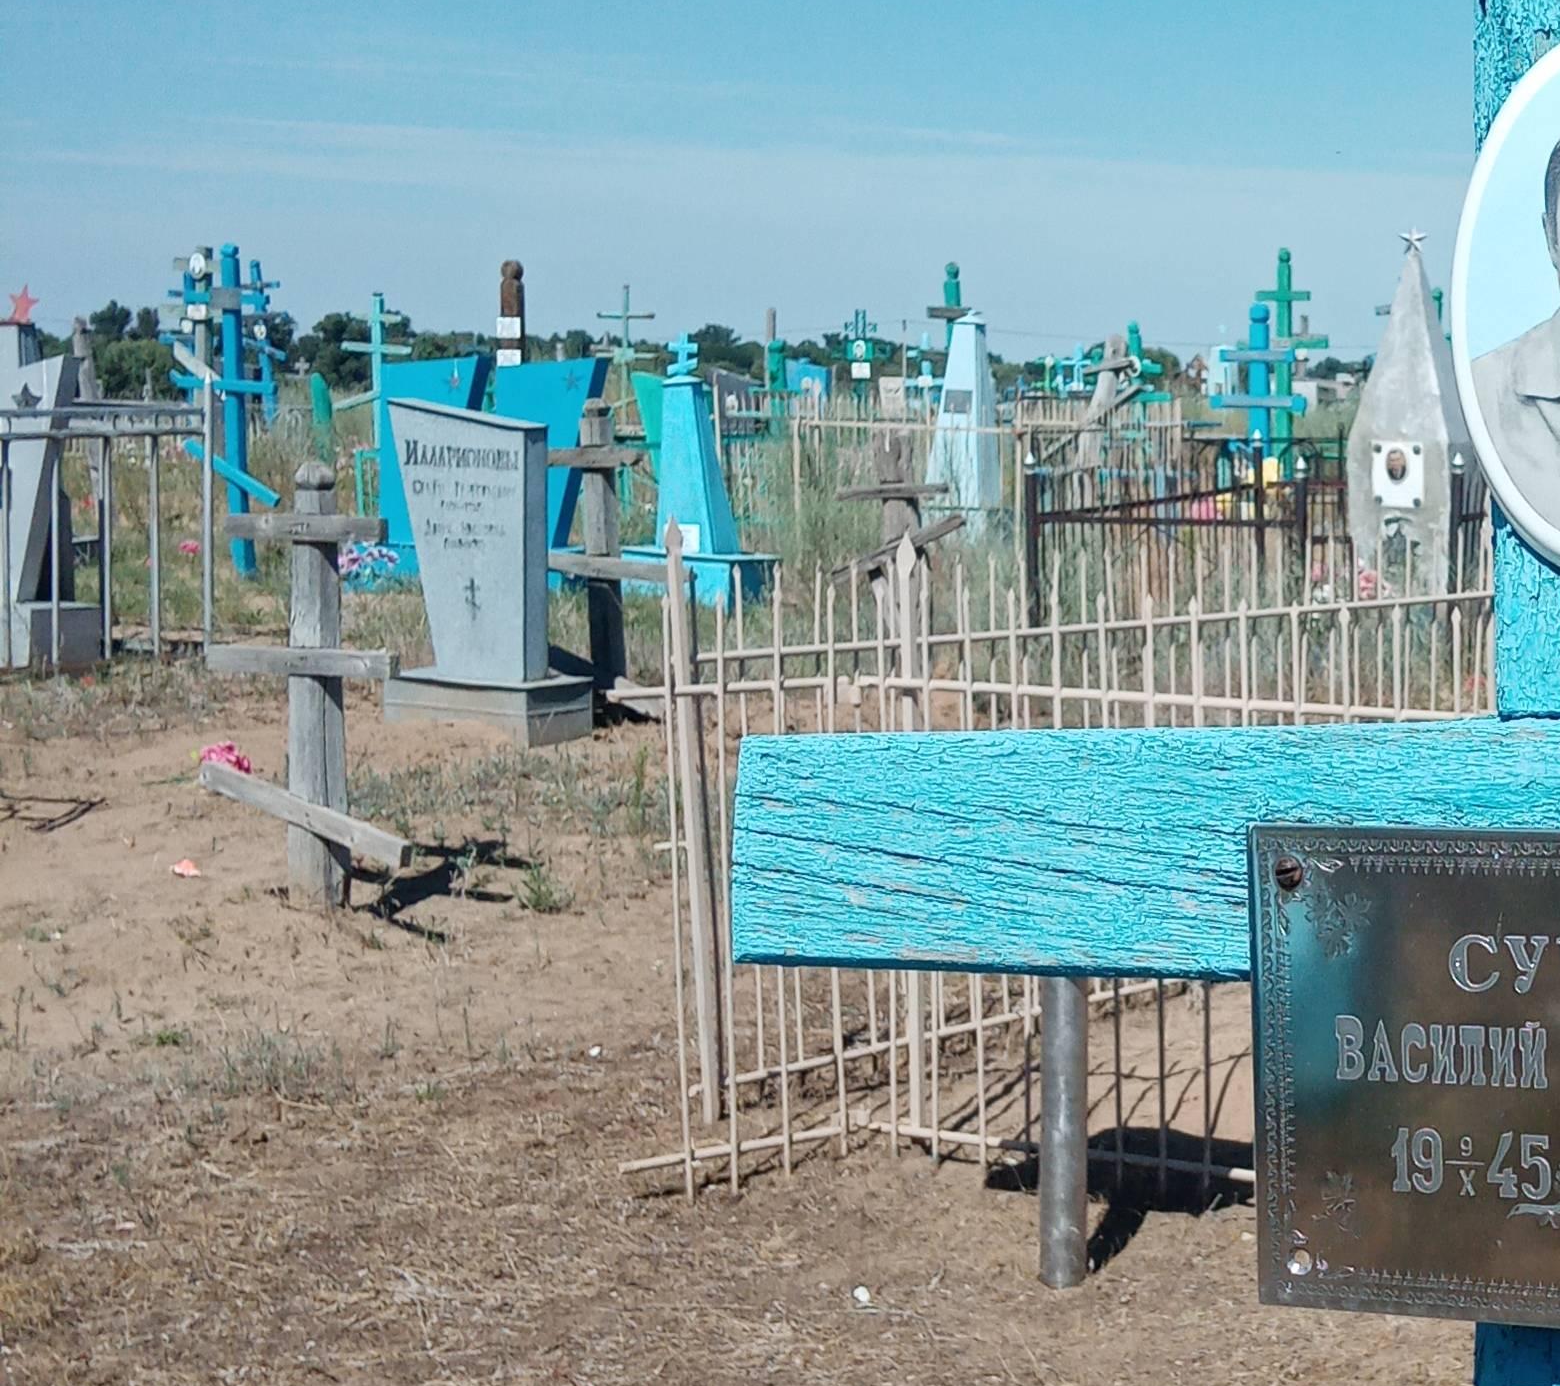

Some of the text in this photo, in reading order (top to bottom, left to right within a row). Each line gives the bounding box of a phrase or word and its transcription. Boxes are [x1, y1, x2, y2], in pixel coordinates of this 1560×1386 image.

[1334, 1014, 1550, 1090] ВАСИЛИЙ
[1391, 1127, 1444, 1193] 19
[1459, 1135, 1474, 1158] 9
[1486, 1130, 1553, 1201] 45
